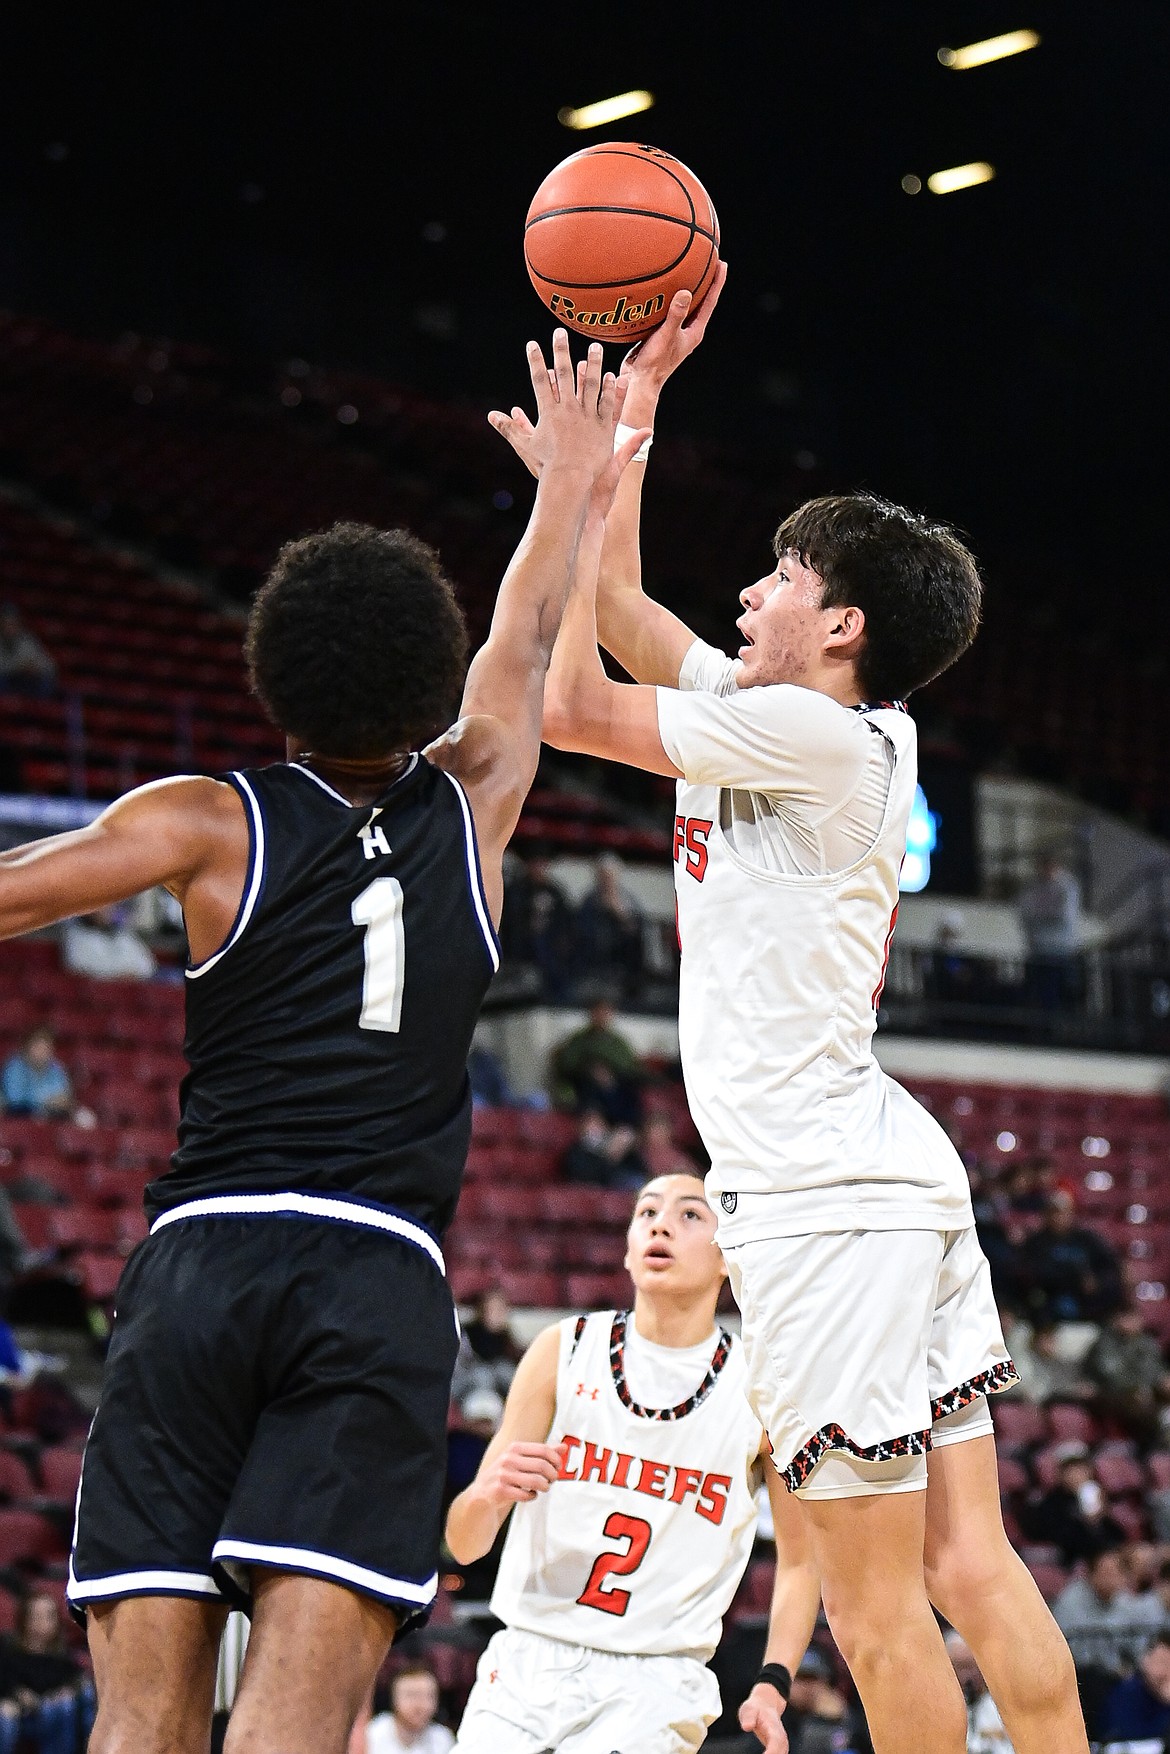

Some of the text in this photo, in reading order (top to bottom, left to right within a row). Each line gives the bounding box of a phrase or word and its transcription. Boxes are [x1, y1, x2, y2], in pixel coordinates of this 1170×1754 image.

[550, 293, 664, 326] Baden
[351, 877, 405, 1033] 1
[576, 1512, 651, 1616] 2
